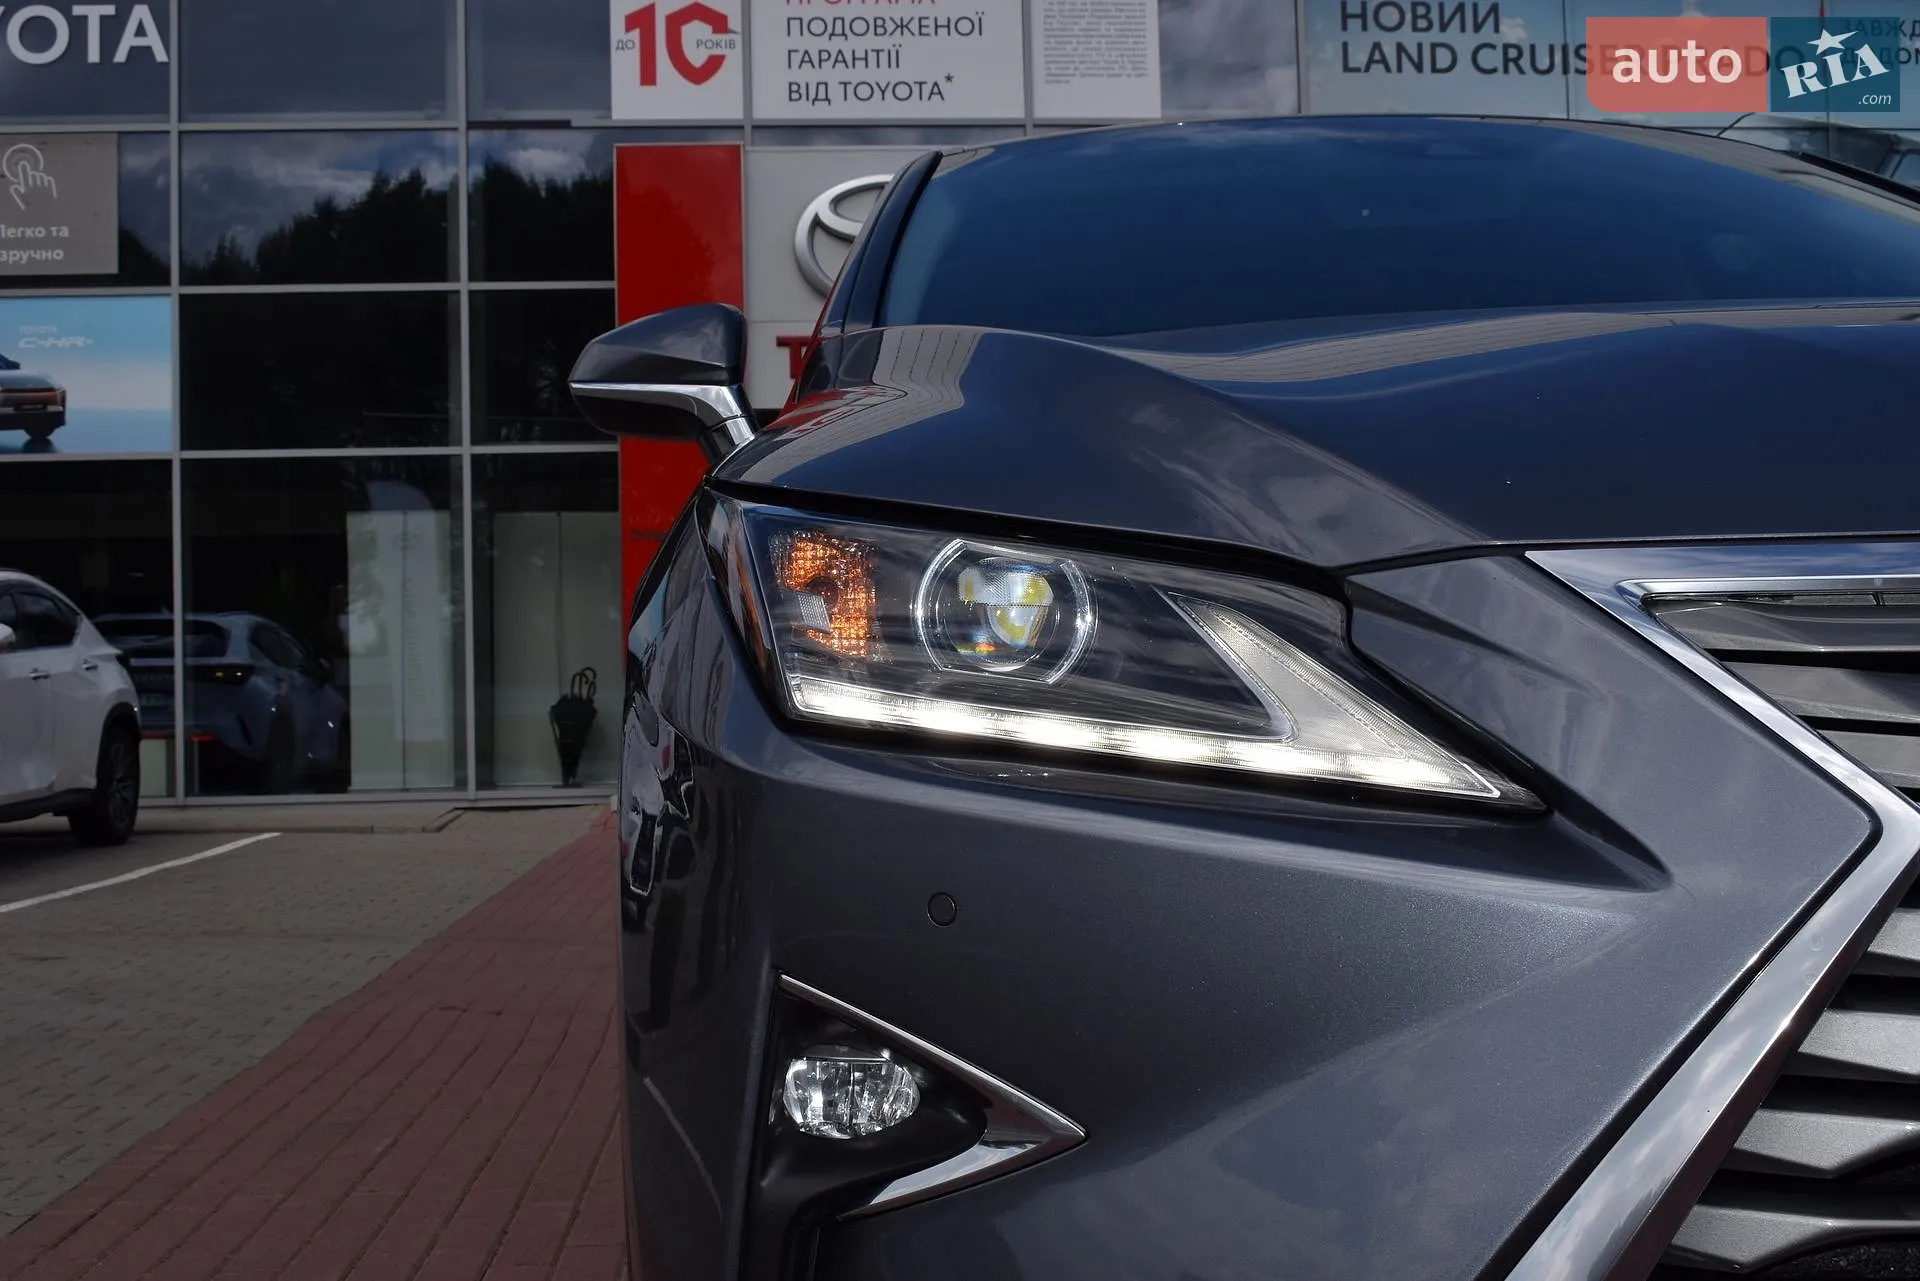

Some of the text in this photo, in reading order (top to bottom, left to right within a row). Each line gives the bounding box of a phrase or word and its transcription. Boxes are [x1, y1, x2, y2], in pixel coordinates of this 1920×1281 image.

[0, 4, 169, 65] OTA
[786, 11, 986, 41] ПОДОВЖЕНОЇ
[615, 39, 636, 51] ДО
[696, 39, 737, 50] РОКІВ
[787, 43, 903, 70] ГАРАНТІЇ
[1341, 41, 1459, 74] LAND
[788, 81, 831, 106] ВІД
[49, 226, 69, 237] та
[0, 249, 64, 264] зручно
